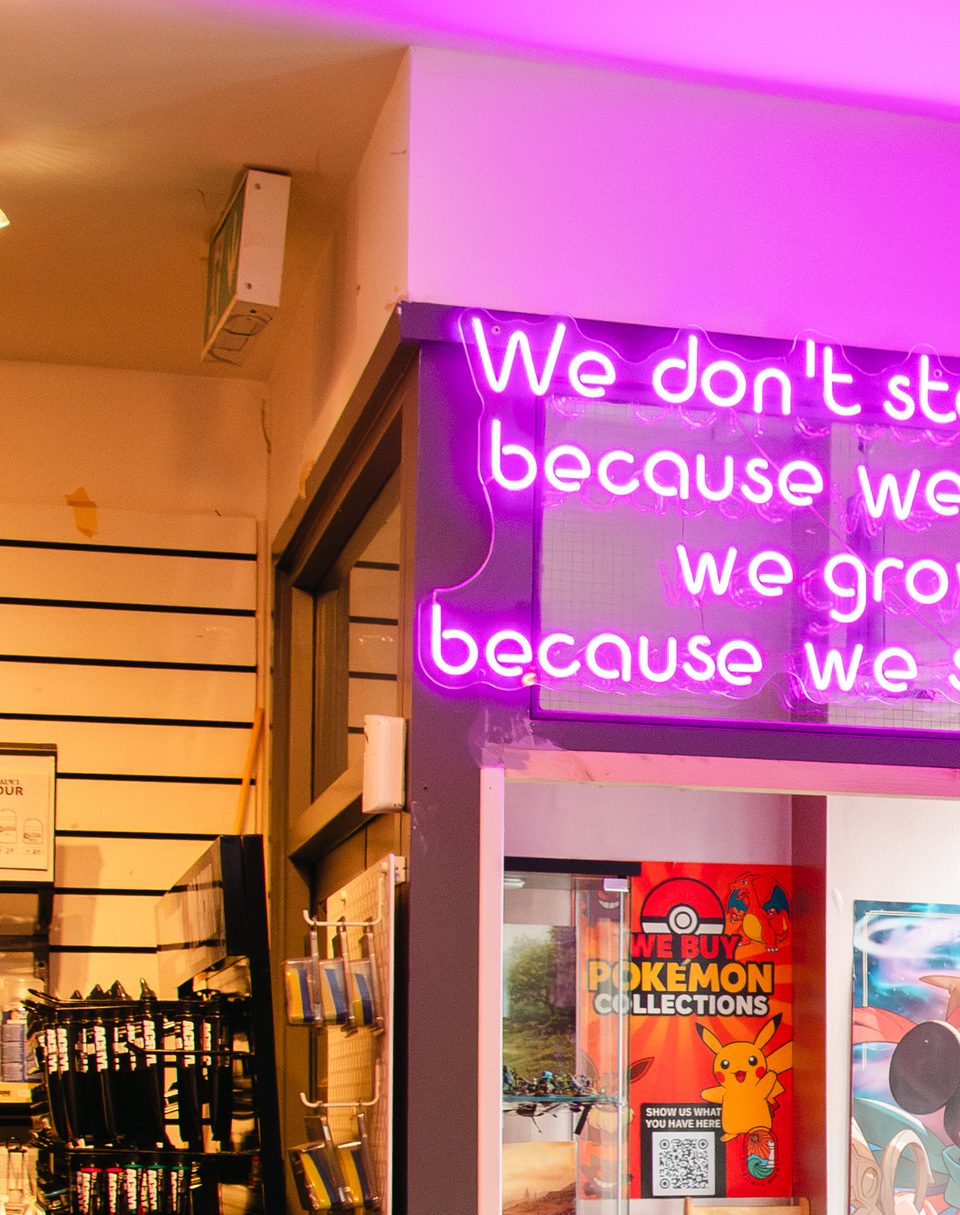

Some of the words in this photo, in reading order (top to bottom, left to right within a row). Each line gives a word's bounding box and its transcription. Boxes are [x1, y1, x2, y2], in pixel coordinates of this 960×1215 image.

[472, 316, 616, 397] We
[652, 335, 861, 416] don't
[490, 419, 824, 507] because
[676, 544, 794, 596] we
[432, 603, 764, 686] because
[804, 641, 918, 692] we
[630, 933, 673, 958] WE
[680, 933, 742, 960] BUY
[588, 957, 774, 993] POKÉMON
[594, 994, 770, 1016] COLLECTIONS
[645, 1107, 677, 1117] SHOW
[679, 1107, 692, 1117] US
[694, 1107, 722, 1117] WHAT
[645, 1118, 666, 1129] YOU
[668, 1118, 694, 1129] HAVE
[696, 1118, 722, 1129] HERE
